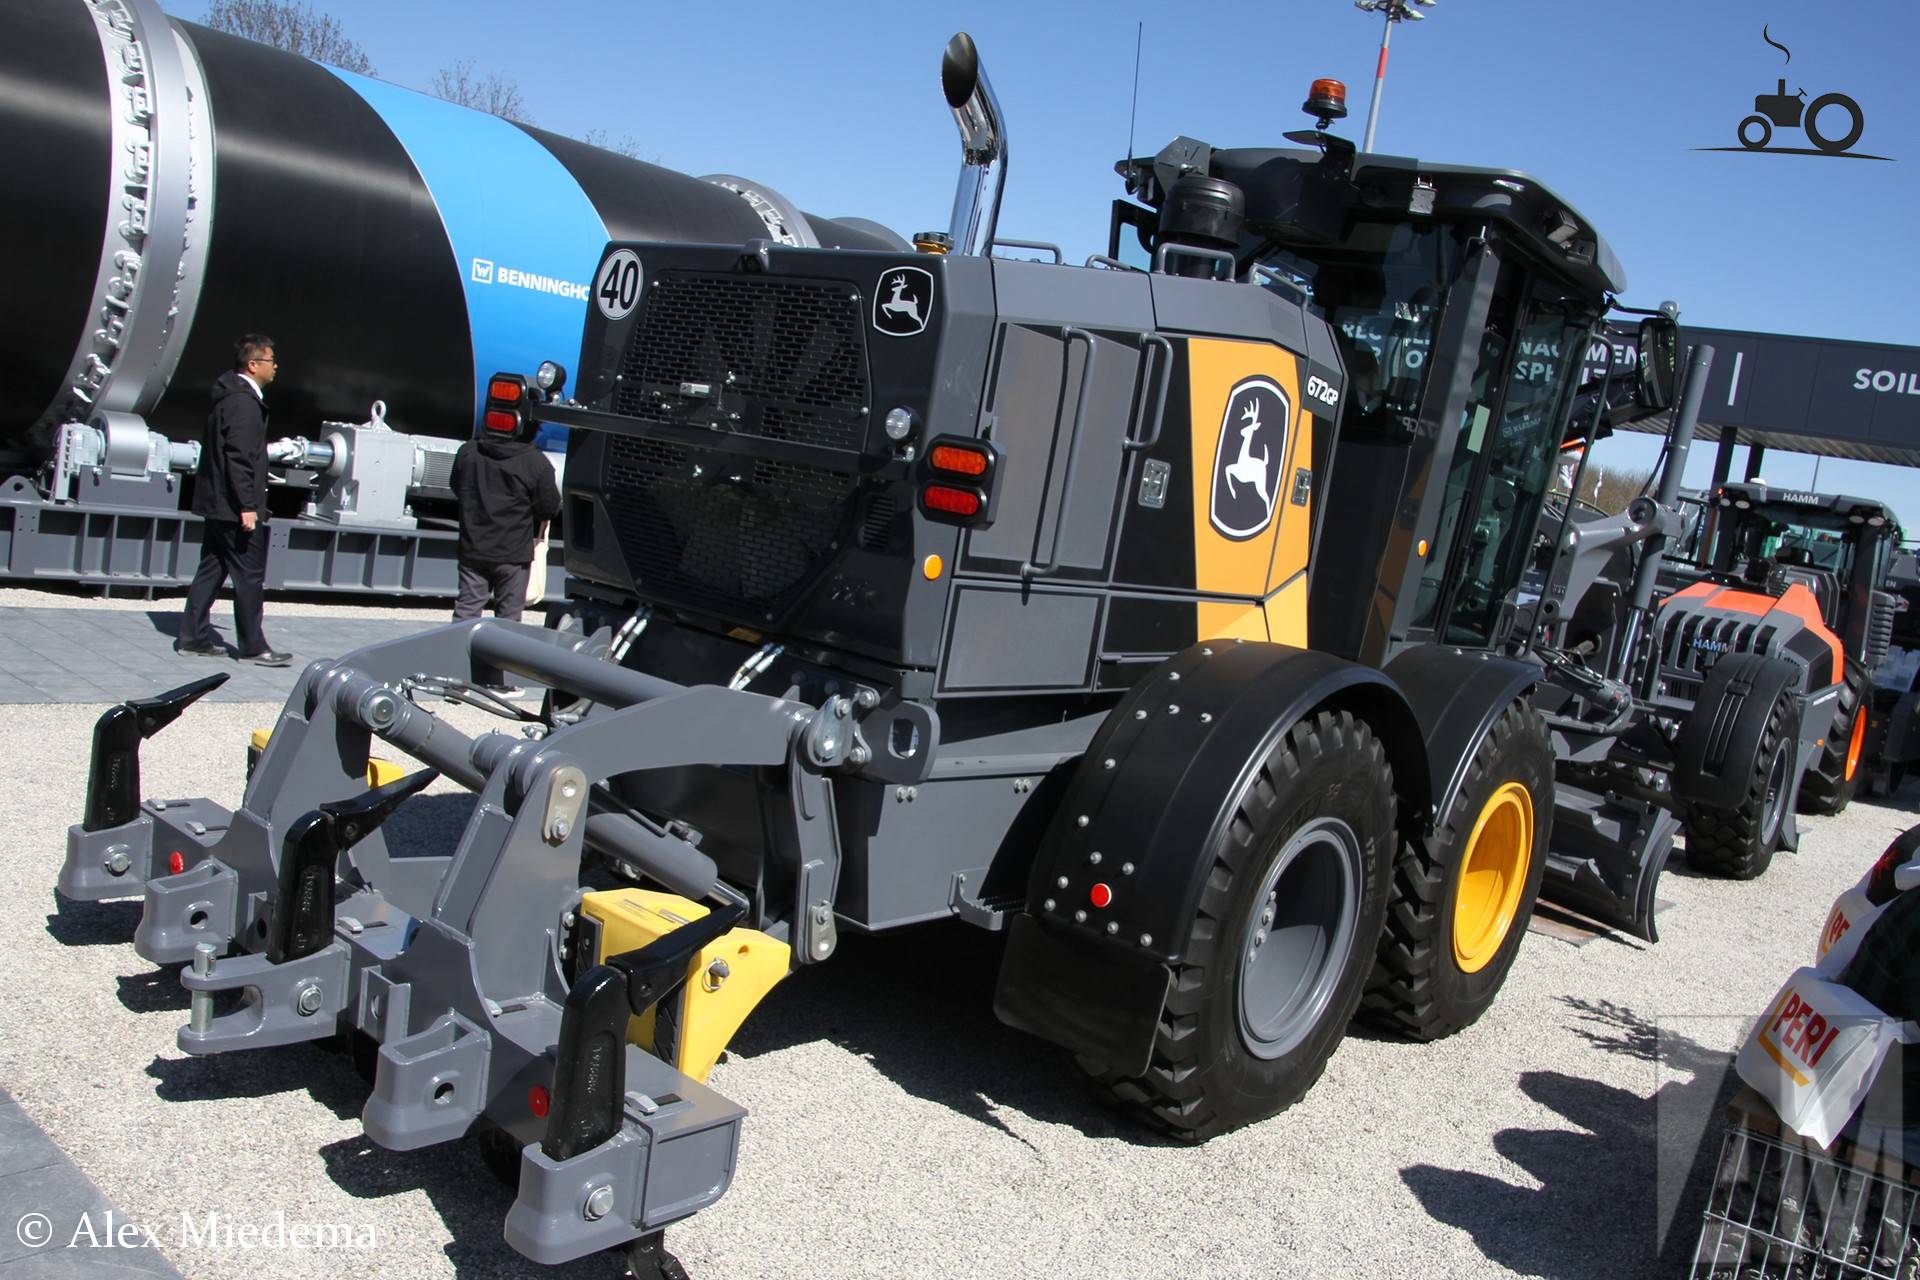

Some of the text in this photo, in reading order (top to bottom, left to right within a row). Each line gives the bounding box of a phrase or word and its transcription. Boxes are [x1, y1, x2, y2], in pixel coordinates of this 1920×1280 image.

[600, 259, 639, 310] 40
[1307, 375, 1339, 406] 672GP
[1853, 368, 1920, 395] SOIL
[1783, 492, 1819, 505] HAMM
[1692, 638, 1734, 653] HAMM
[1773, 993, 1840, 1069] PERI
